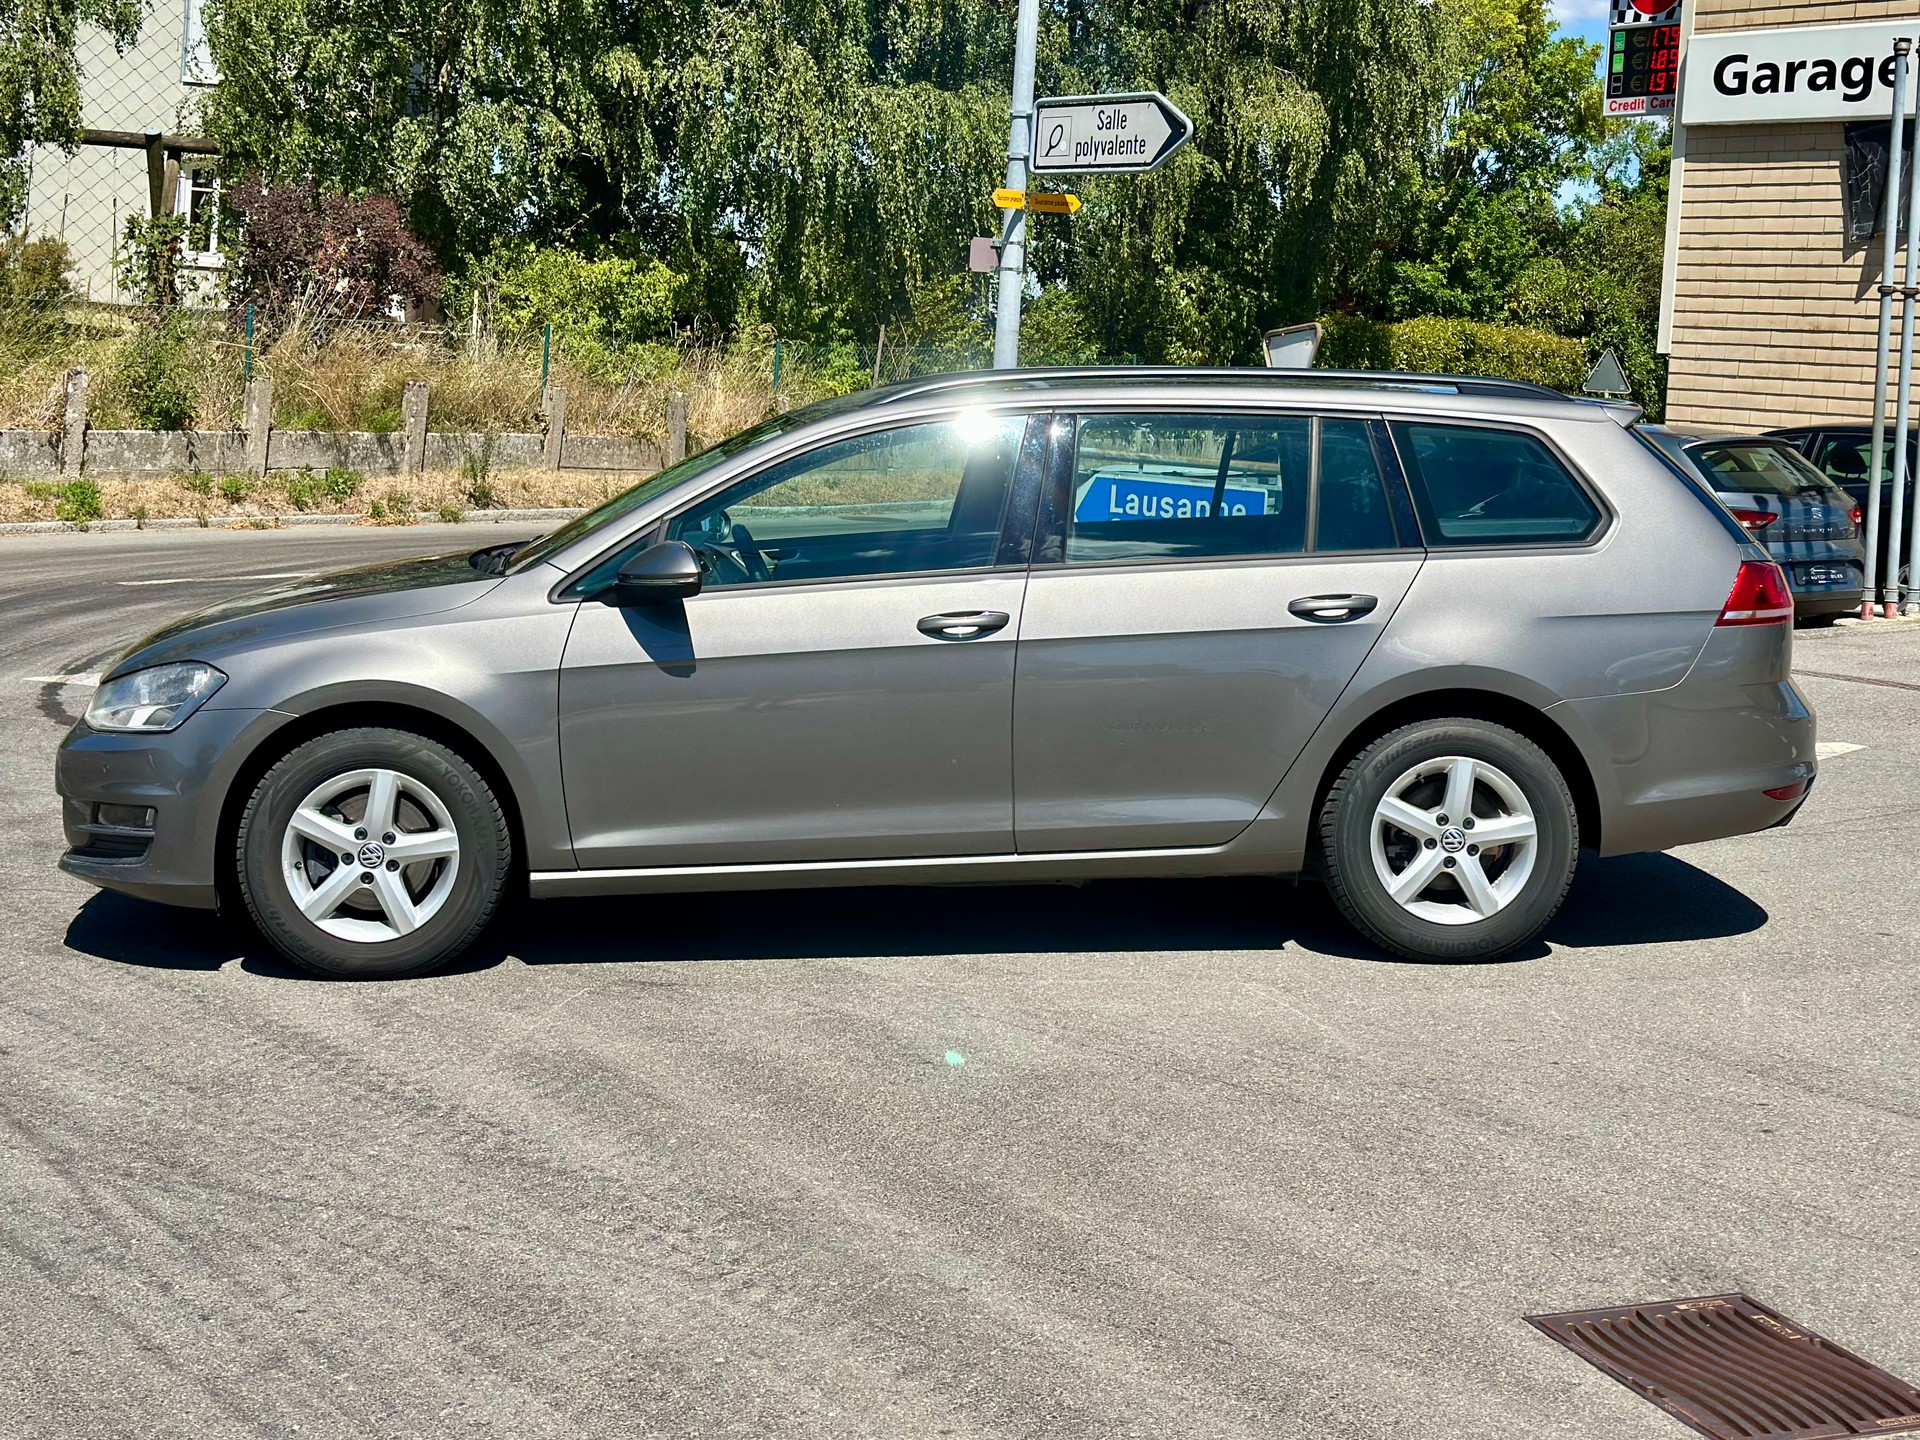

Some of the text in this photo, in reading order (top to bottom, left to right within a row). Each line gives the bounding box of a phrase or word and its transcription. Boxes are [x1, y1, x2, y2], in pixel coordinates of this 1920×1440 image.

[1713, 52, 1909, 103] Garage
[1609, 98, 1646, 112] Credit
[1097, 109, 1128, 131] Salle
[1075, 134, 1146, 162] polyvalente
